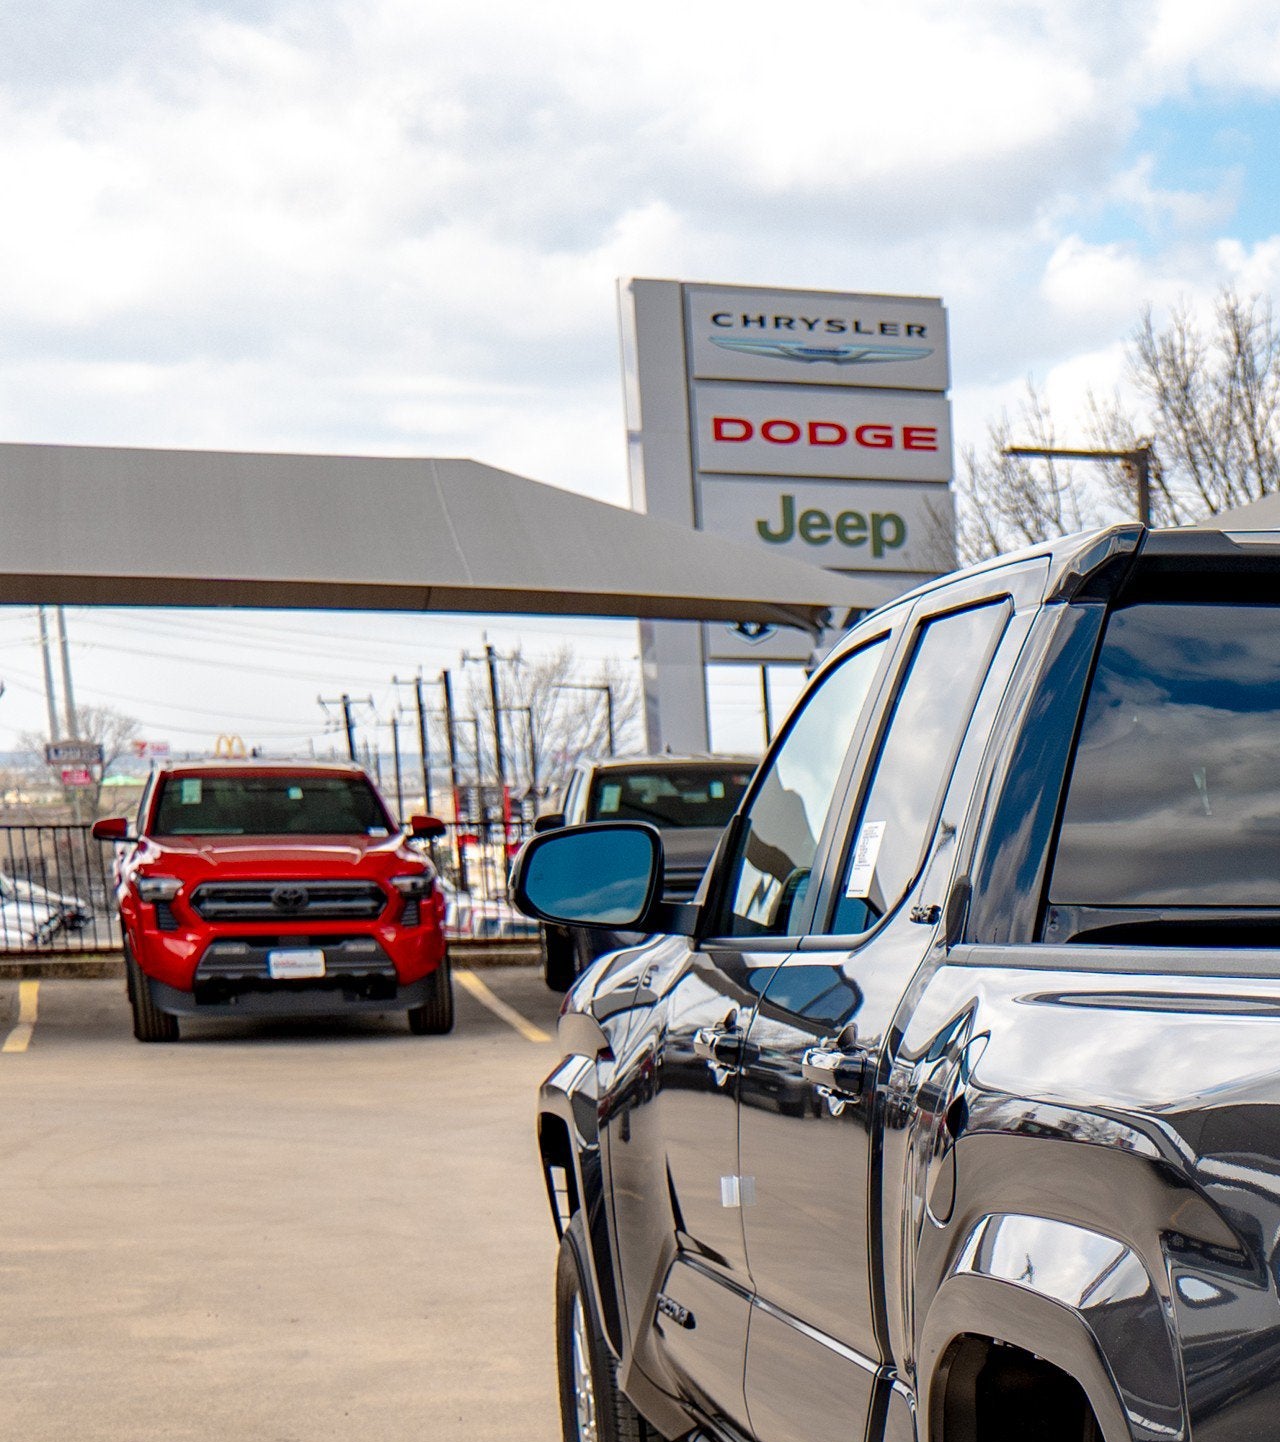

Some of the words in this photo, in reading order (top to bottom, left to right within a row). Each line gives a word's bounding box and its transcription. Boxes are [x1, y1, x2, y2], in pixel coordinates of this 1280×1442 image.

[711, 312, 928, 339] CHRYSLER
[712, 416, 939, 452] DODGE
[756, 495, 907, 558] Jeep
